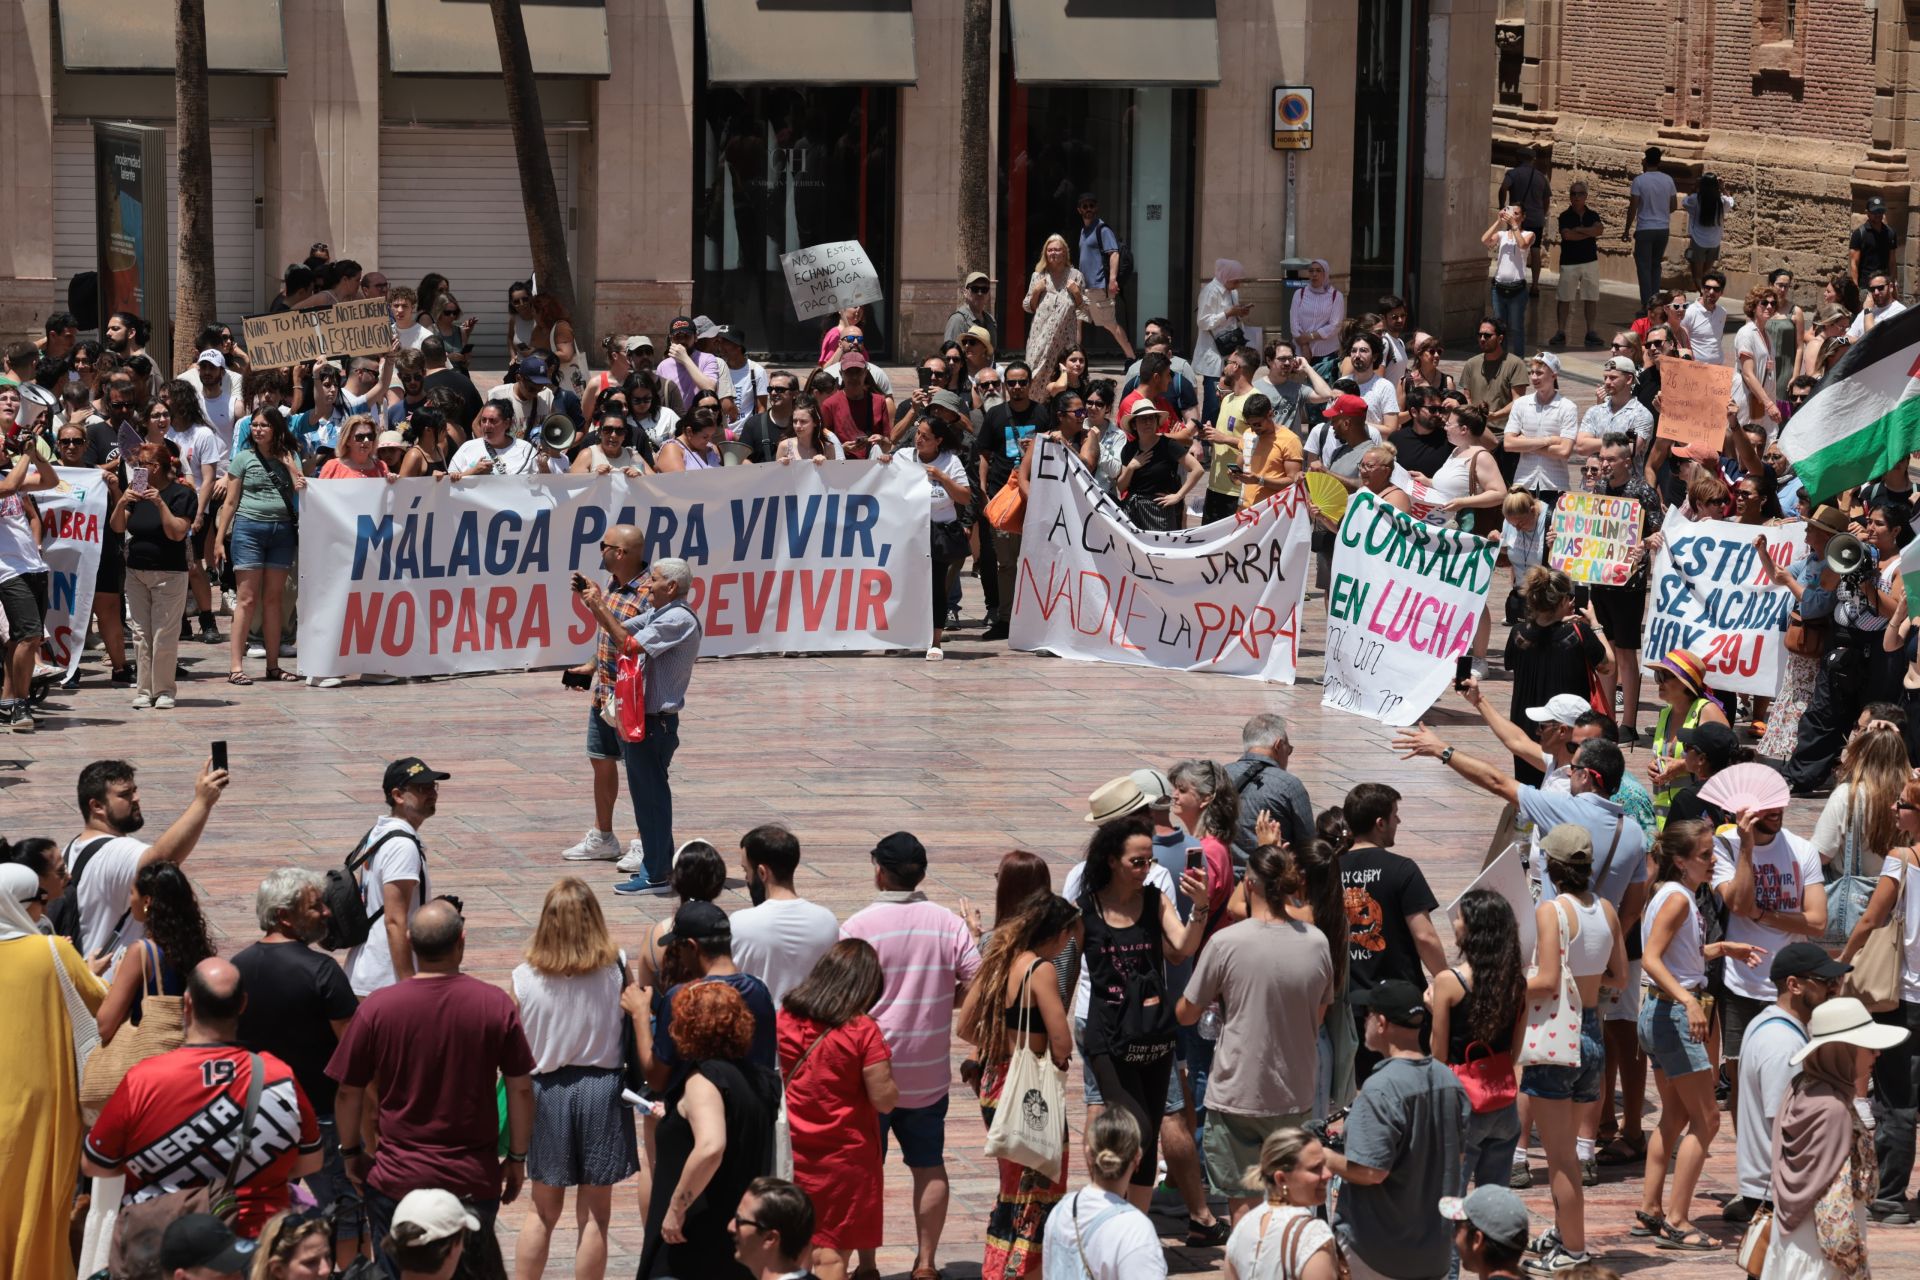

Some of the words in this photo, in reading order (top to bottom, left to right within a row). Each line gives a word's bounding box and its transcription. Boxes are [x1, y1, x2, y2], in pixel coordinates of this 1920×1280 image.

[115, 153, 141, 169] modernidad
[771, 148, 808, 173] CH
[792, 253, 817, 268] NOS
[794, 261, 846, 286] ECHANDO
[850, 257, 863, 266] DE
[274, 318, 290, 333] TU
[292, 310, 335, 332] MADRE
[335, 305, 348, 324] NO
[347, 304, 359, 320] TE
[801, 294, 838, 312] PACO
[264, 337, 300, 365] JUGAR
[300, 333, 317, 358] CON
[317, 331, 328, 354] LA
[1557, 494, 1621, 517] COMERCIO
[1621, 502, 1640, 522] DE
[44, 508, 99, 544] ABRA
[351, 496, 552, 581] MÁLAGA
[730, 493, 892, 568] VIVIR,
[1555, 514, 1638, 545] INQUILINOS
[1047, 504, 1072, 546] A
[1195, 538, 1286, 585] JARA
[1341, 491, 1500, 595] CORRALAS
[1553, 536, 1614, 560] DIASPORA
[1617, 545, 1635, 564] DE
[1552, 556, 1630, 585] VECINOS
[1670, 535, 1758, 585] ESTO
[1015, 557, 1146, 651] NADIE
[1158, 606, 1191, 649] LA
[1194, 602, 1298, 668] PARA
[1330, 572, 1371, 625] EN
[1368, 578, 1475, 663] LUCHA
[1656, 574, 1696, 618] SE
[1693, 587, 1792, 632] ACABA
[338, 590, 416, 657] NO
[429, 584, 551, 656] PARA
[1354, 636, 1385, 675] un
[1645, 617, 1706, 661] HOY
[1702, 633, 1764, 677] 29J
[1351, 868, 1382, 883] CREEPY
[1767, 873, 1795, 886] VIVIR,
[201, 1058, 236, 1087] 19
[126, 1094, 239, 1179] PUERTA
